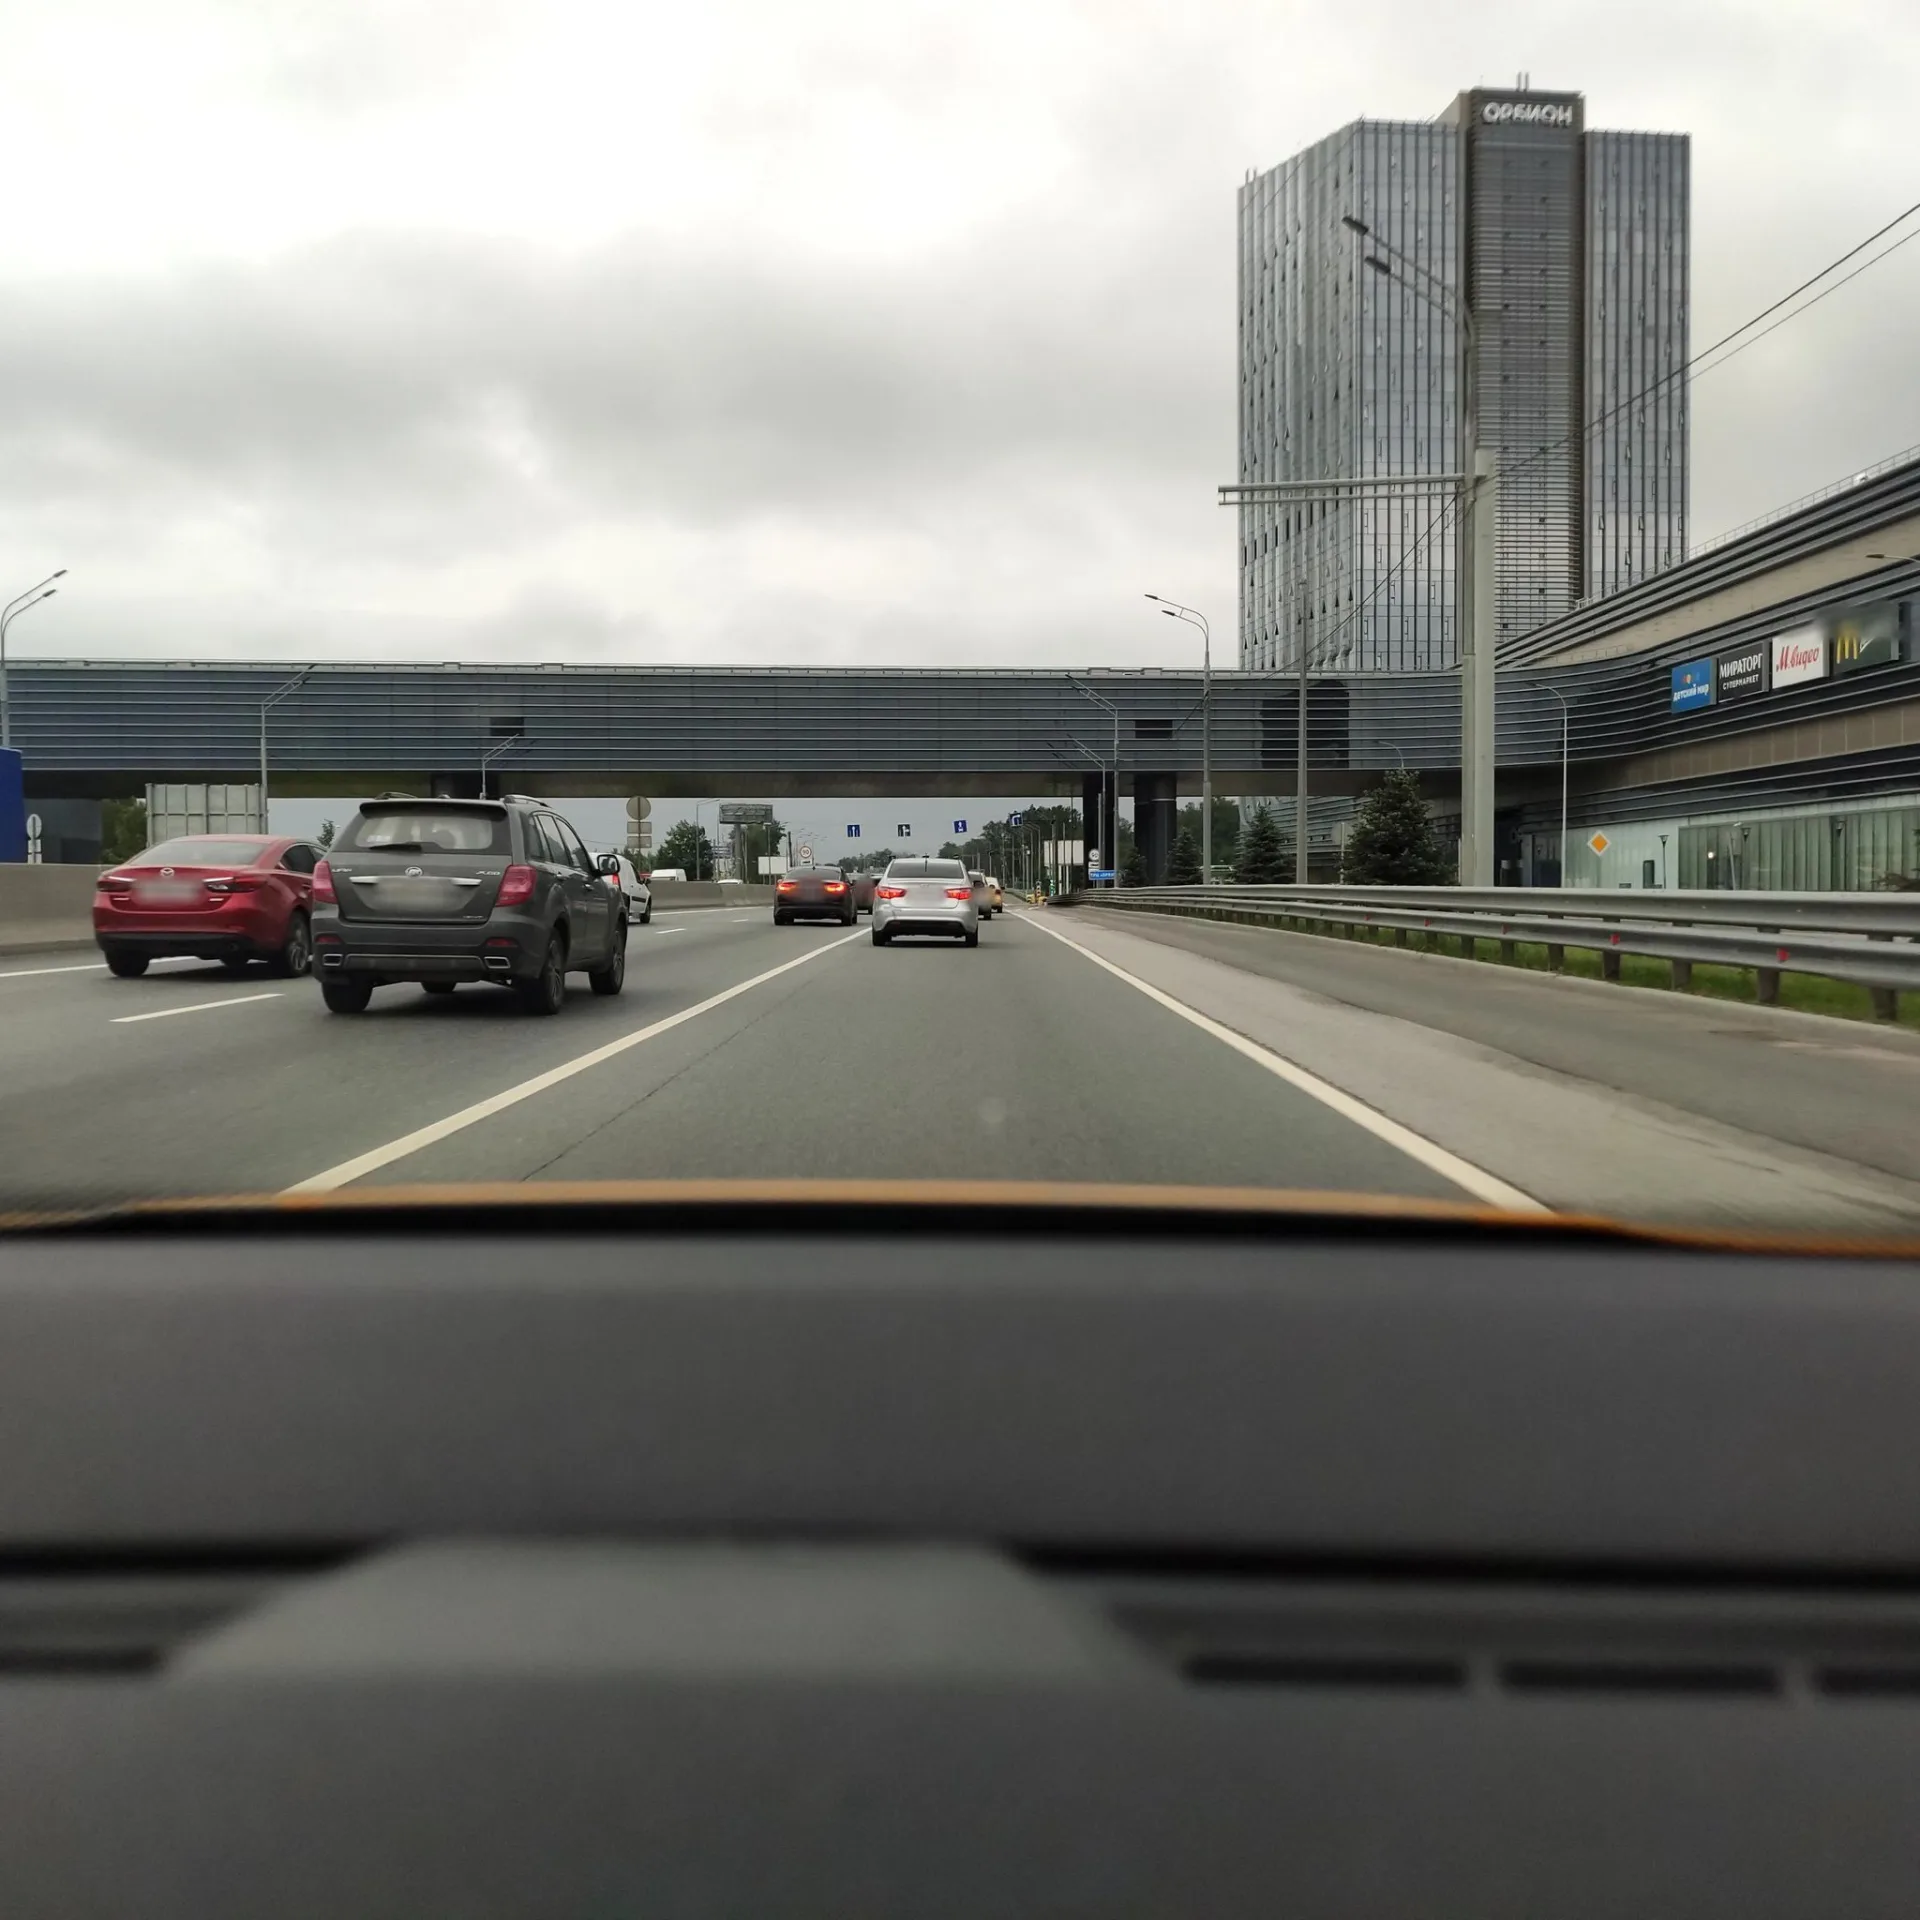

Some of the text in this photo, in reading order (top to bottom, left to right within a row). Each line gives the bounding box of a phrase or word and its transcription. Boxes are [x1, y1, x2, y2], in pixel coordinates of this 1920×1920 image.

[1483, 102, 1573, 125] ОРБИОН
[1719, 653, 1763, 679] МИРАТОРГ
[1722, 674, 1759, 690] СУПЕРМАРКЕТ
